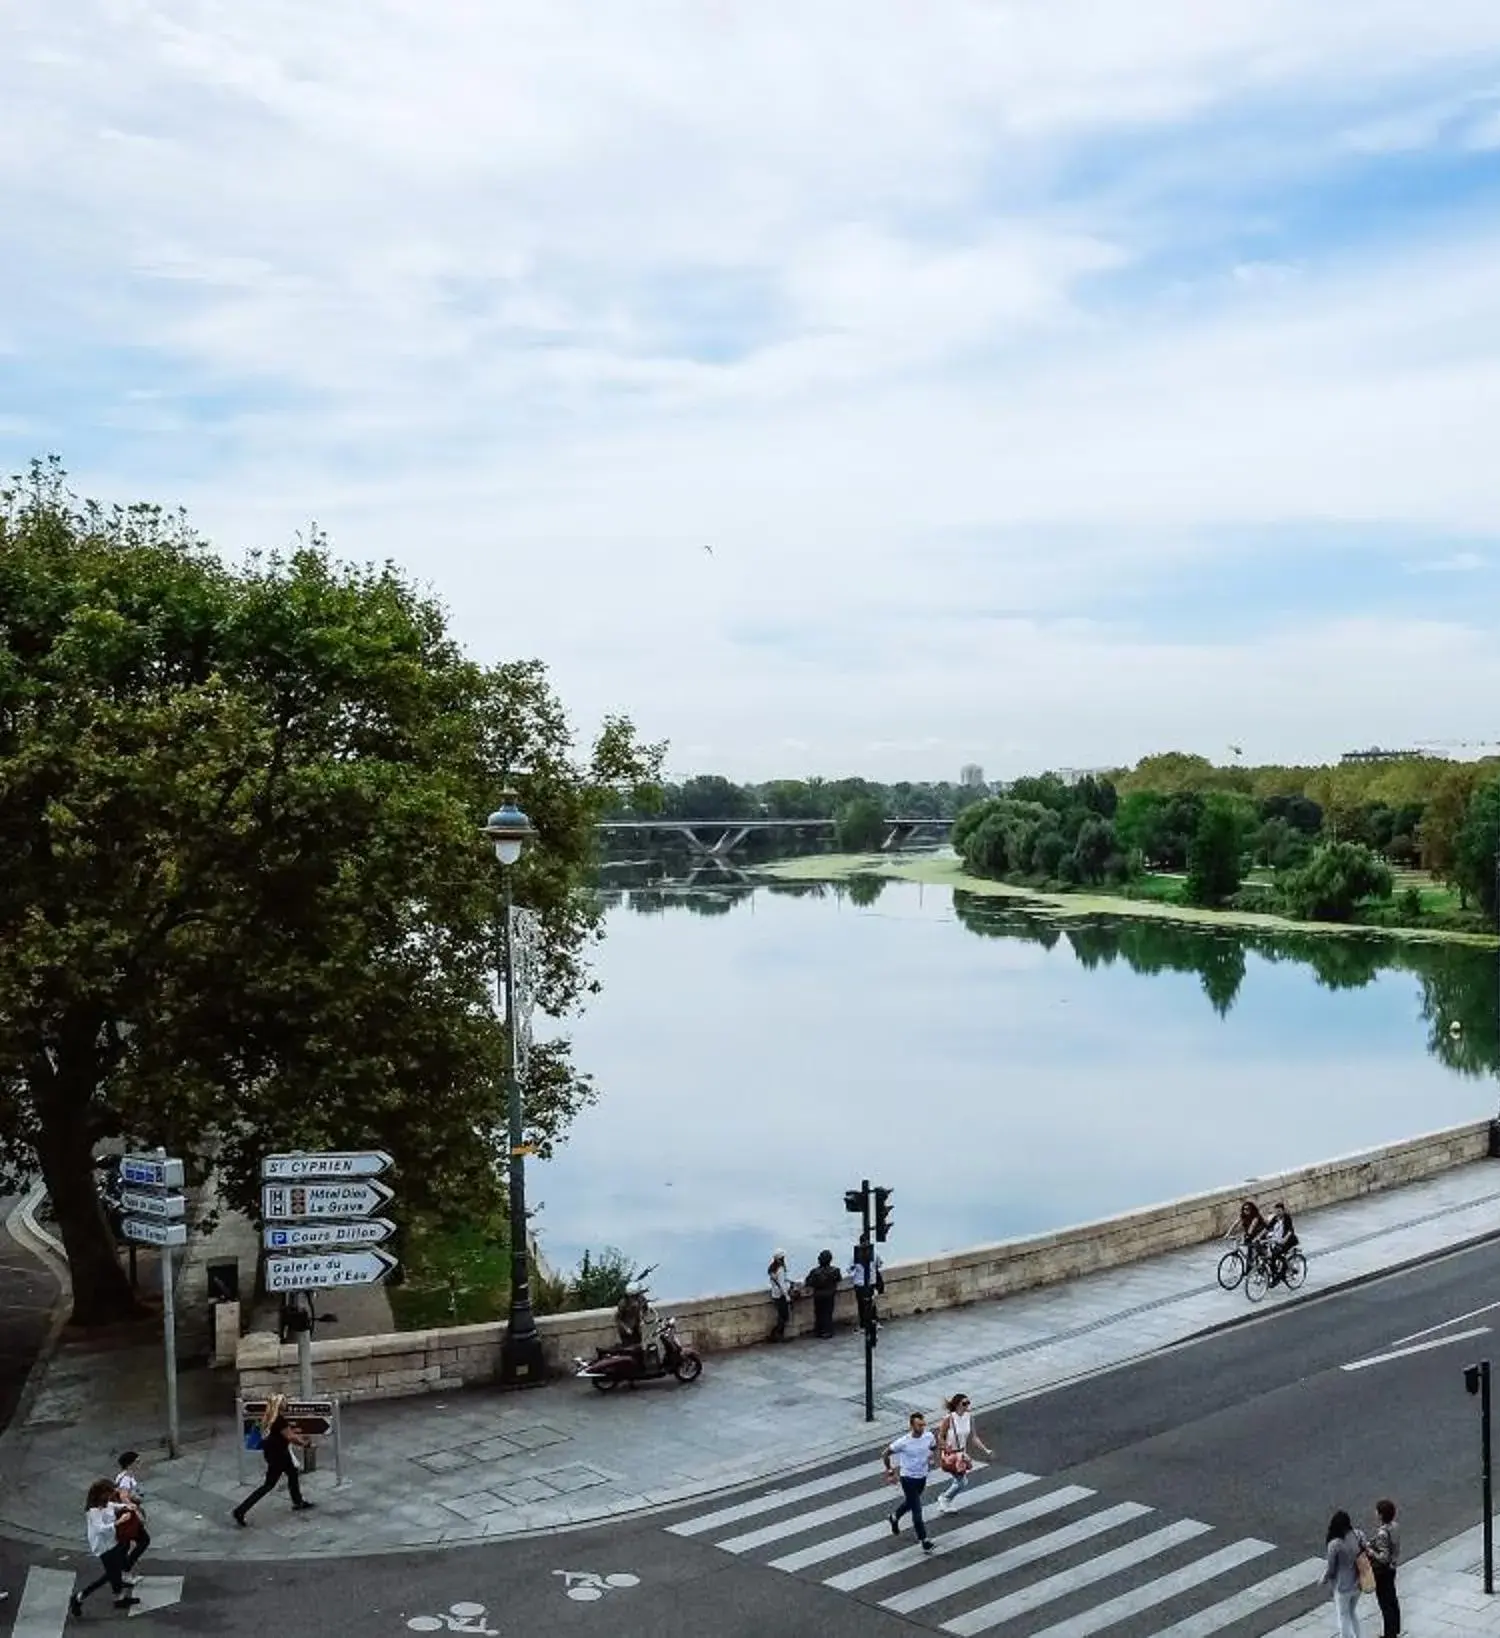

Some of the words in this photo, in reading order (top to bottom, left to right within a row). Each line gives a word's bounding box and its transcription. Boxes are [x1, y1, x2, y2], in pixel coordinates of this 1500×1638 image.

[292, 1160, 353, 1172] CYPRIEN
[329, 1202, 363, 1212] Grave
[292, 1232, 330, 1242] Cours
[337, 1228, 376, 1239] Dillon
[273, 1263, 320, 1273] Galerie
[326, 1259, 341, 1269] du
[273, 1275, 327, 1286] Château
[334, 1271, 368, 1282] d'Eau
